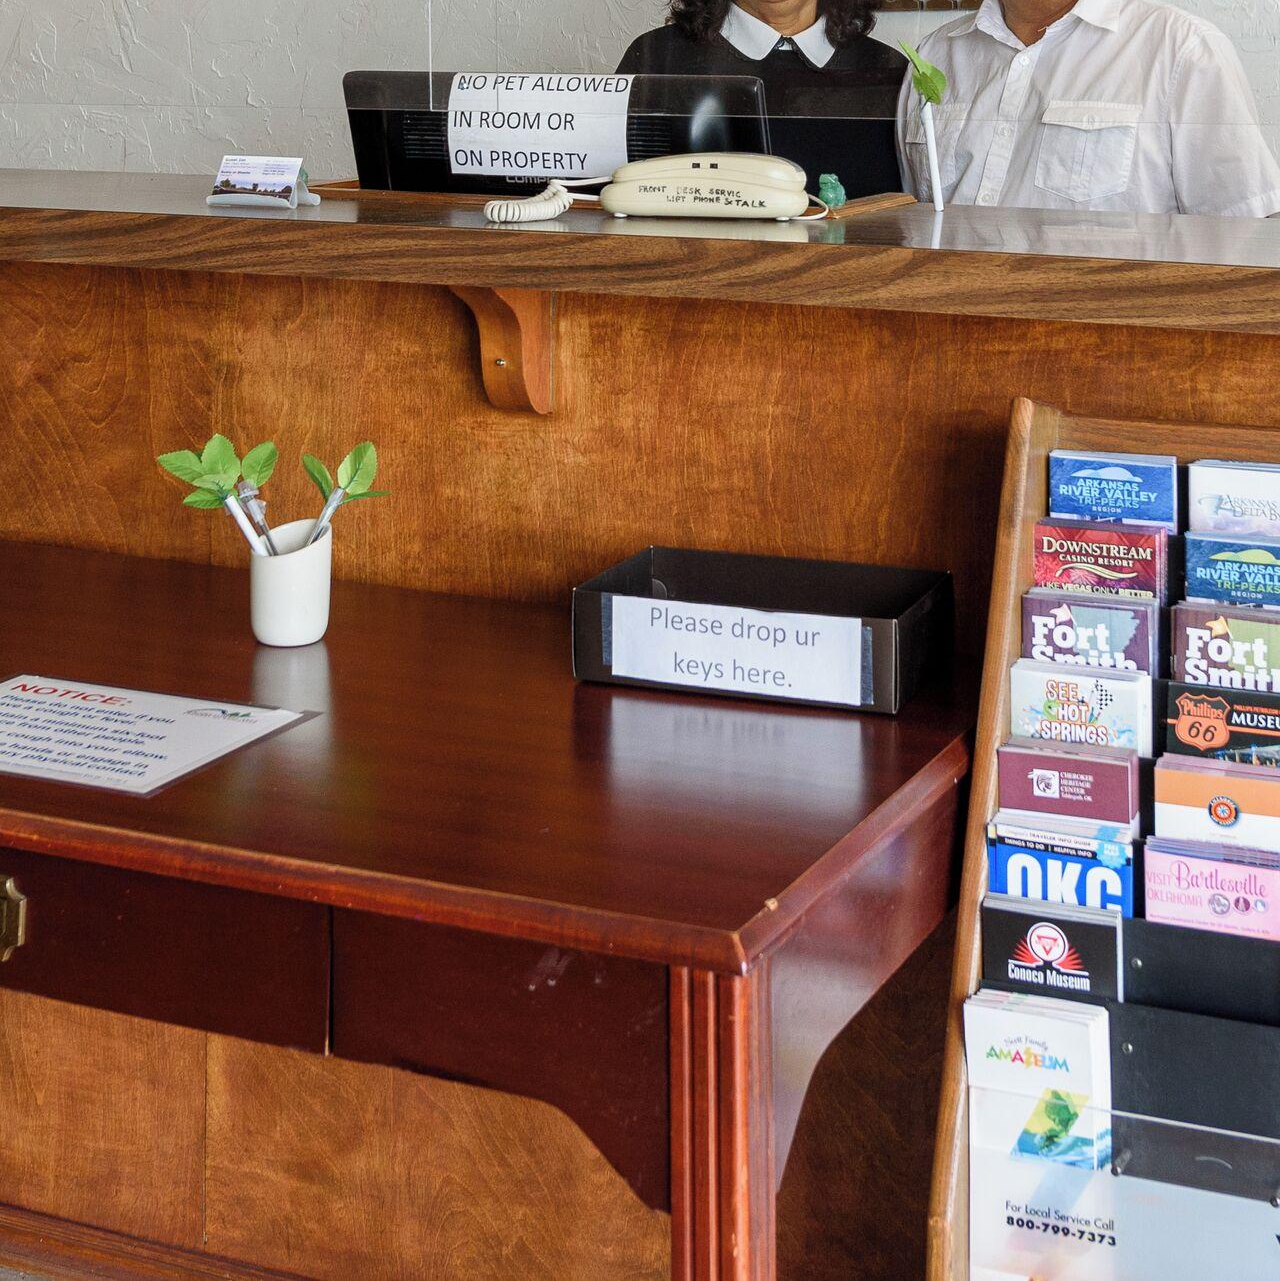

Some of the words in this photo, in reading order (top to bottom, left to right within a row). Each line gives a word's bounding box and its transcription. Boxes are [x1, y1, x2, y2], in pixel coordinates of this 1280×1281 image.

[458, 75, 487, 90] NO
[493, 75, 529, 90] PET
[532, 77, 629, 92] ALLOWED
[454, 111, 471, 127] IN
[479, 111, 540, 129] ROOM
[548, 113, 574, 130] OR
[455, 149, 482, 166] ON
[491, 150, 587, 170] PROPERTY
[1042, 536, 1152, 560] DOWNSTREAM
[1196, 568, 1242, 583] RIVER
[650, 607, 723, 636] Please
[731, 617, 787, 648] drop
[795, 630, 820, 646] ur
[1186, 627, 1268, 667] Fort
[673, 652, 724, 680] keys
[732, 659, 793, 688] here.
[1170, 861, 1267, 898] Bartlesville
[1008, 963, 1044, 983] Conoco
[1047, 967, 1090, 991] Museum
[1006, 1216, 1116, 1247] 800-799-7373
